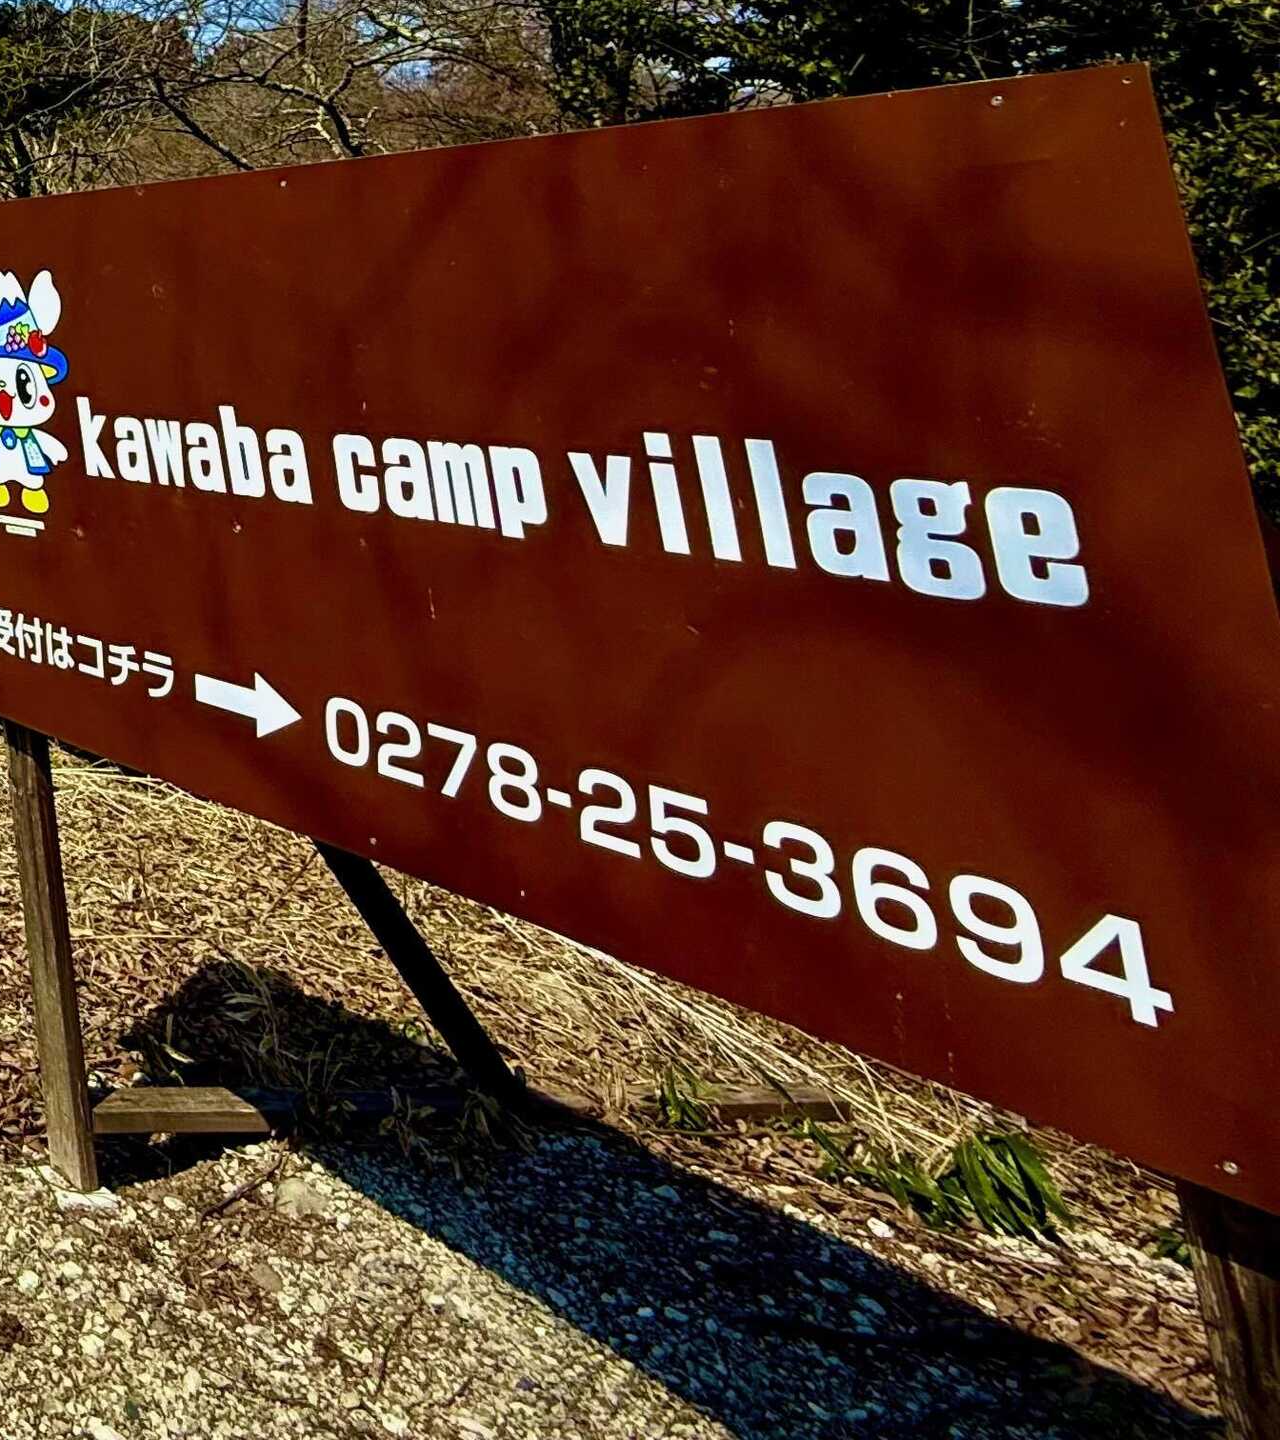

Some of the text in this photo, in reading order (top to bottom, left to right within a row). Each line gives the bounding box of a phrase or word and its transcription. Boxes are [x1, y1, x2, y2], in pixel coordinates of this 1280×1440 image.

[76, 396, 1090, 607] kawaba camp village
[325, 696, 1174, 1028] 0278-25-3694
